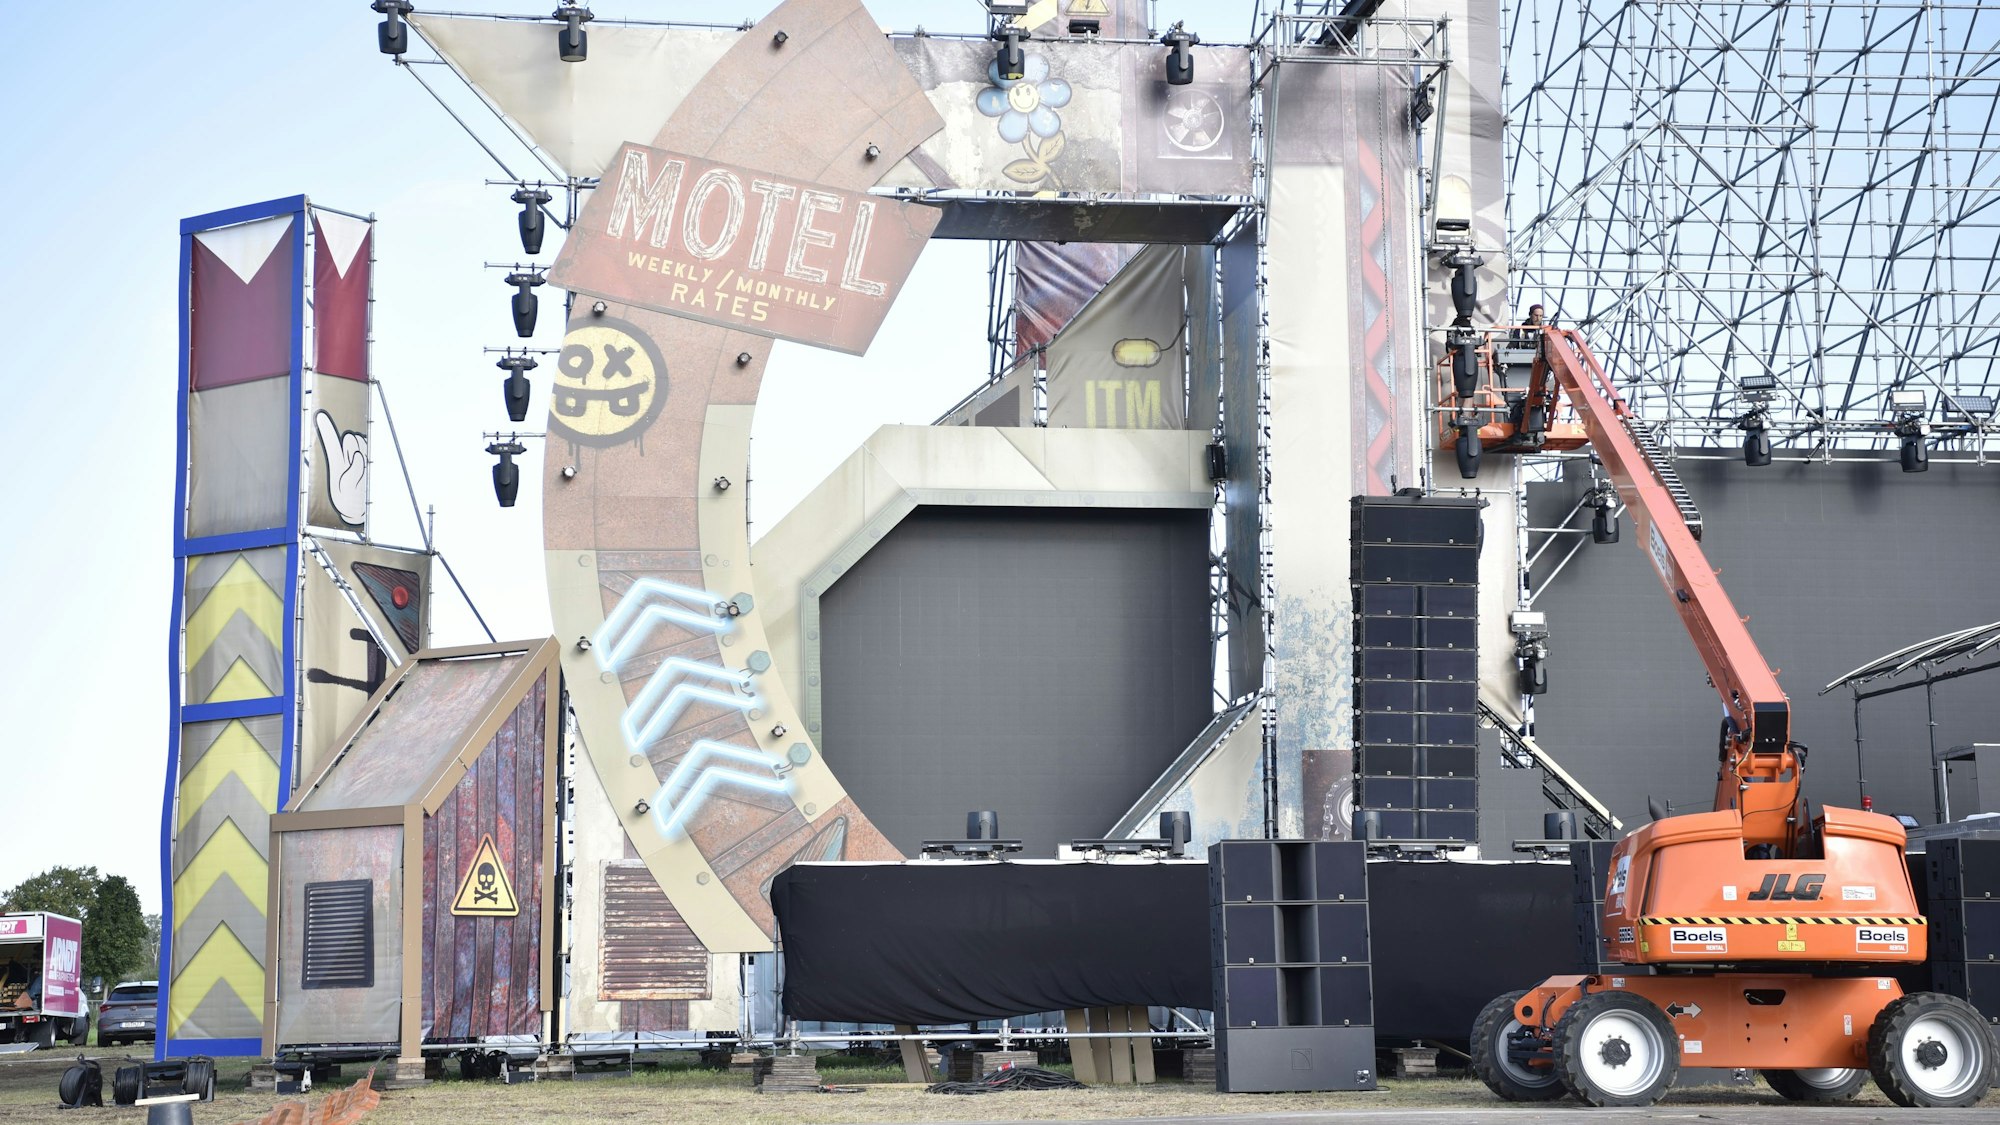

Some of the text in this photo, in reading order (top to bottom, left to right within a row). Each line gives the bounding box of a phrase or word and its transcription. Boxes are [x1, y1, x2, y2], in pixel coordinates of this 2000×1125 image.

[606, 149, 887, 297] MOTEL
[670, 283, 769, 322] RATES
[1747, 874, 1826, 901] JLG
[1673, 930, 1724, 941] Boels
[1859, 930, 1905, 941] Boels
[49, 937, 78, 976] ARNDT
